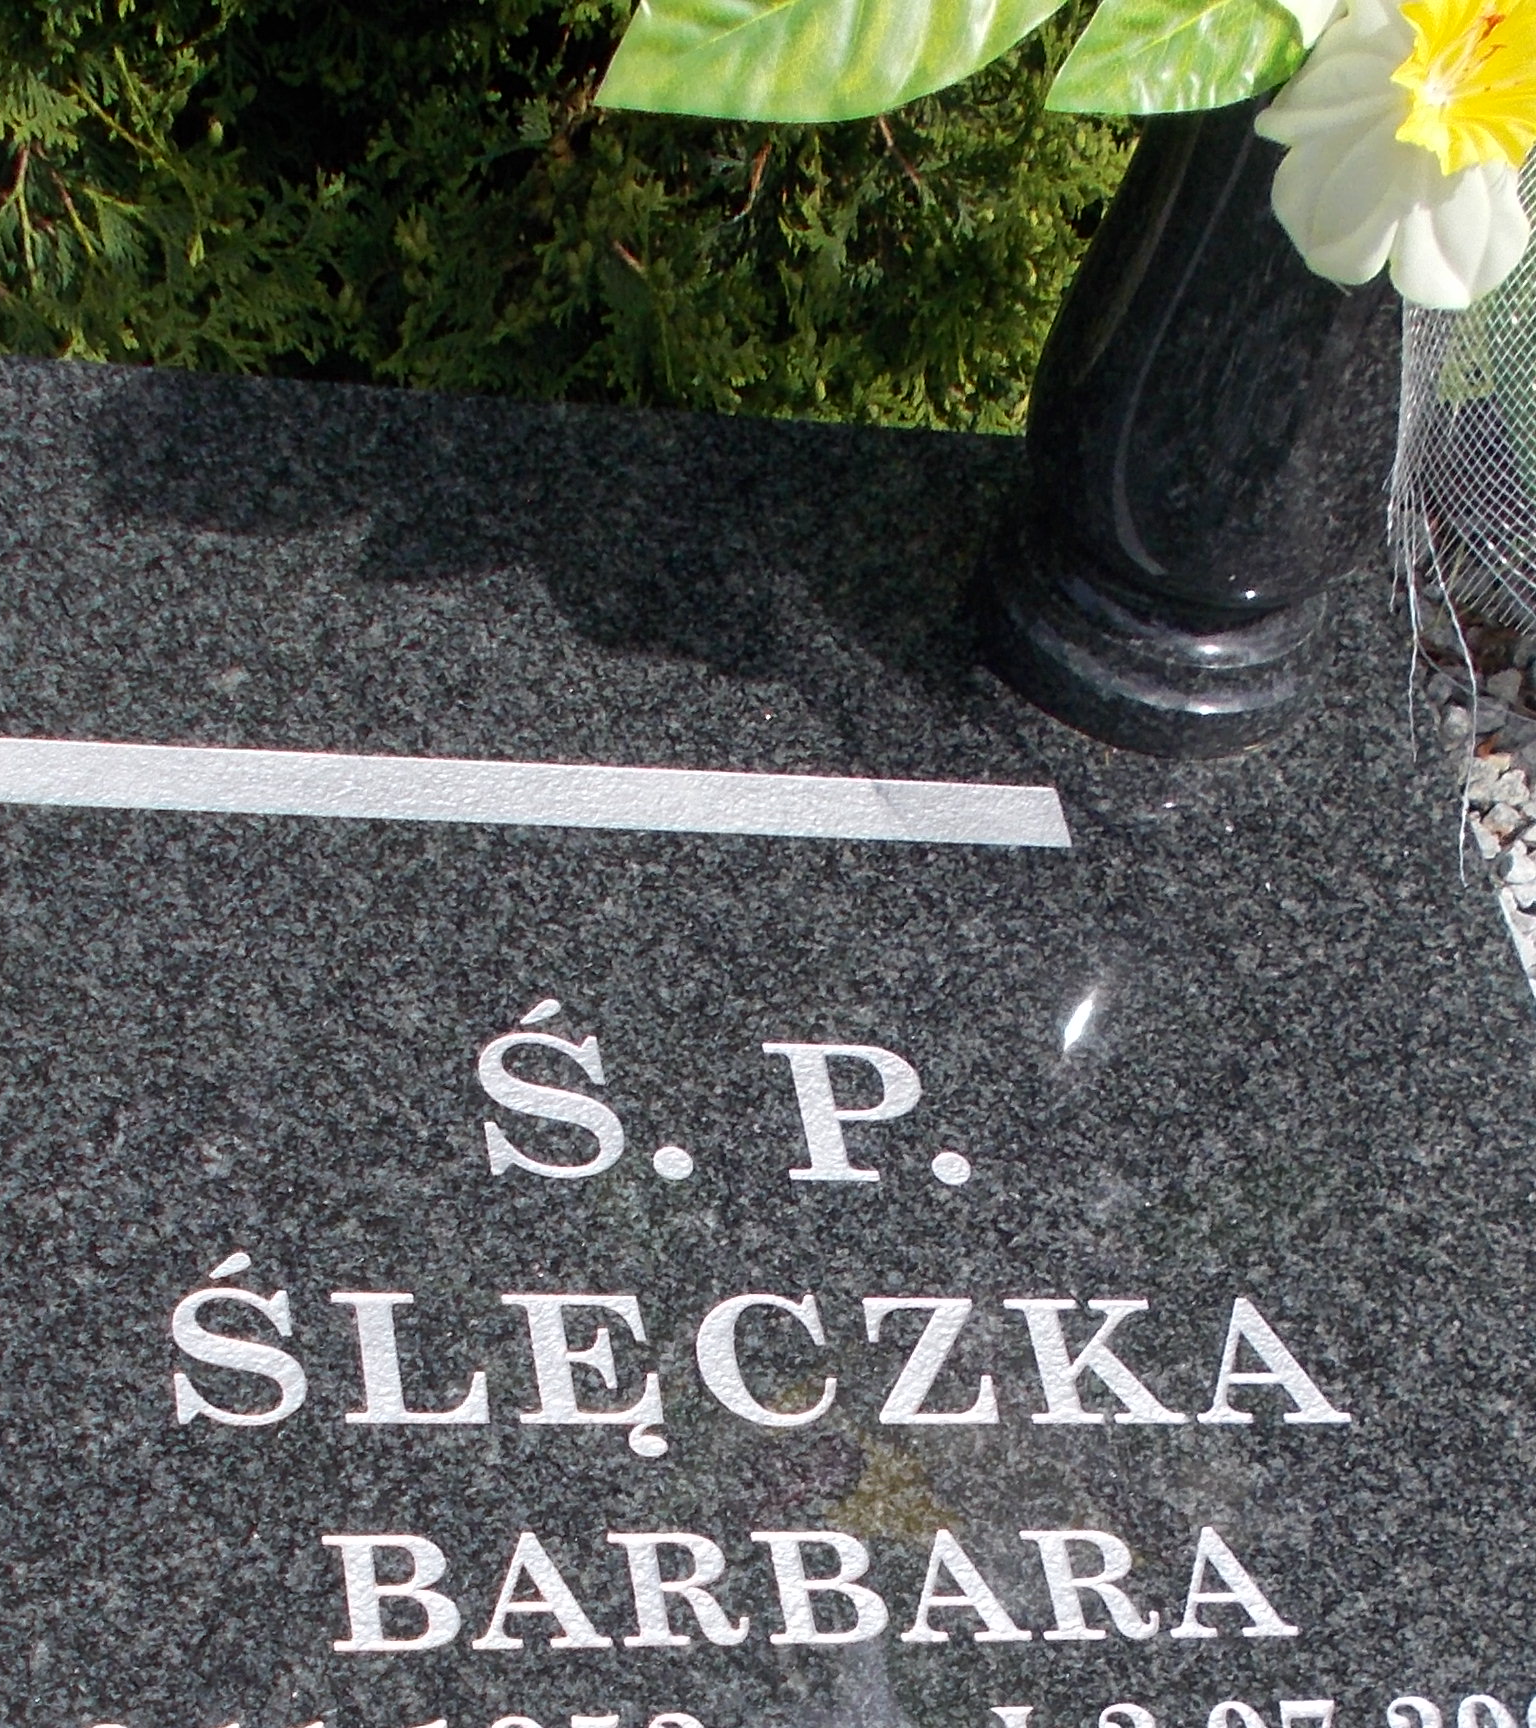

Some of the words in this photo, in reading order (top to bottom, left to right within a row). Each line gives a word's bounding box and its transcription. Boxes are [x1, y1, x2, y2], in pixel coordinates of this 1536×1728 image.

[476, 997, 694, 1181] Ś.
[762, 1040, 972, 1187] P.
[170, 1250, 1353, 1458] ŚLĘCZKA
[321, 1524, 1300, 1653] BARBARA
